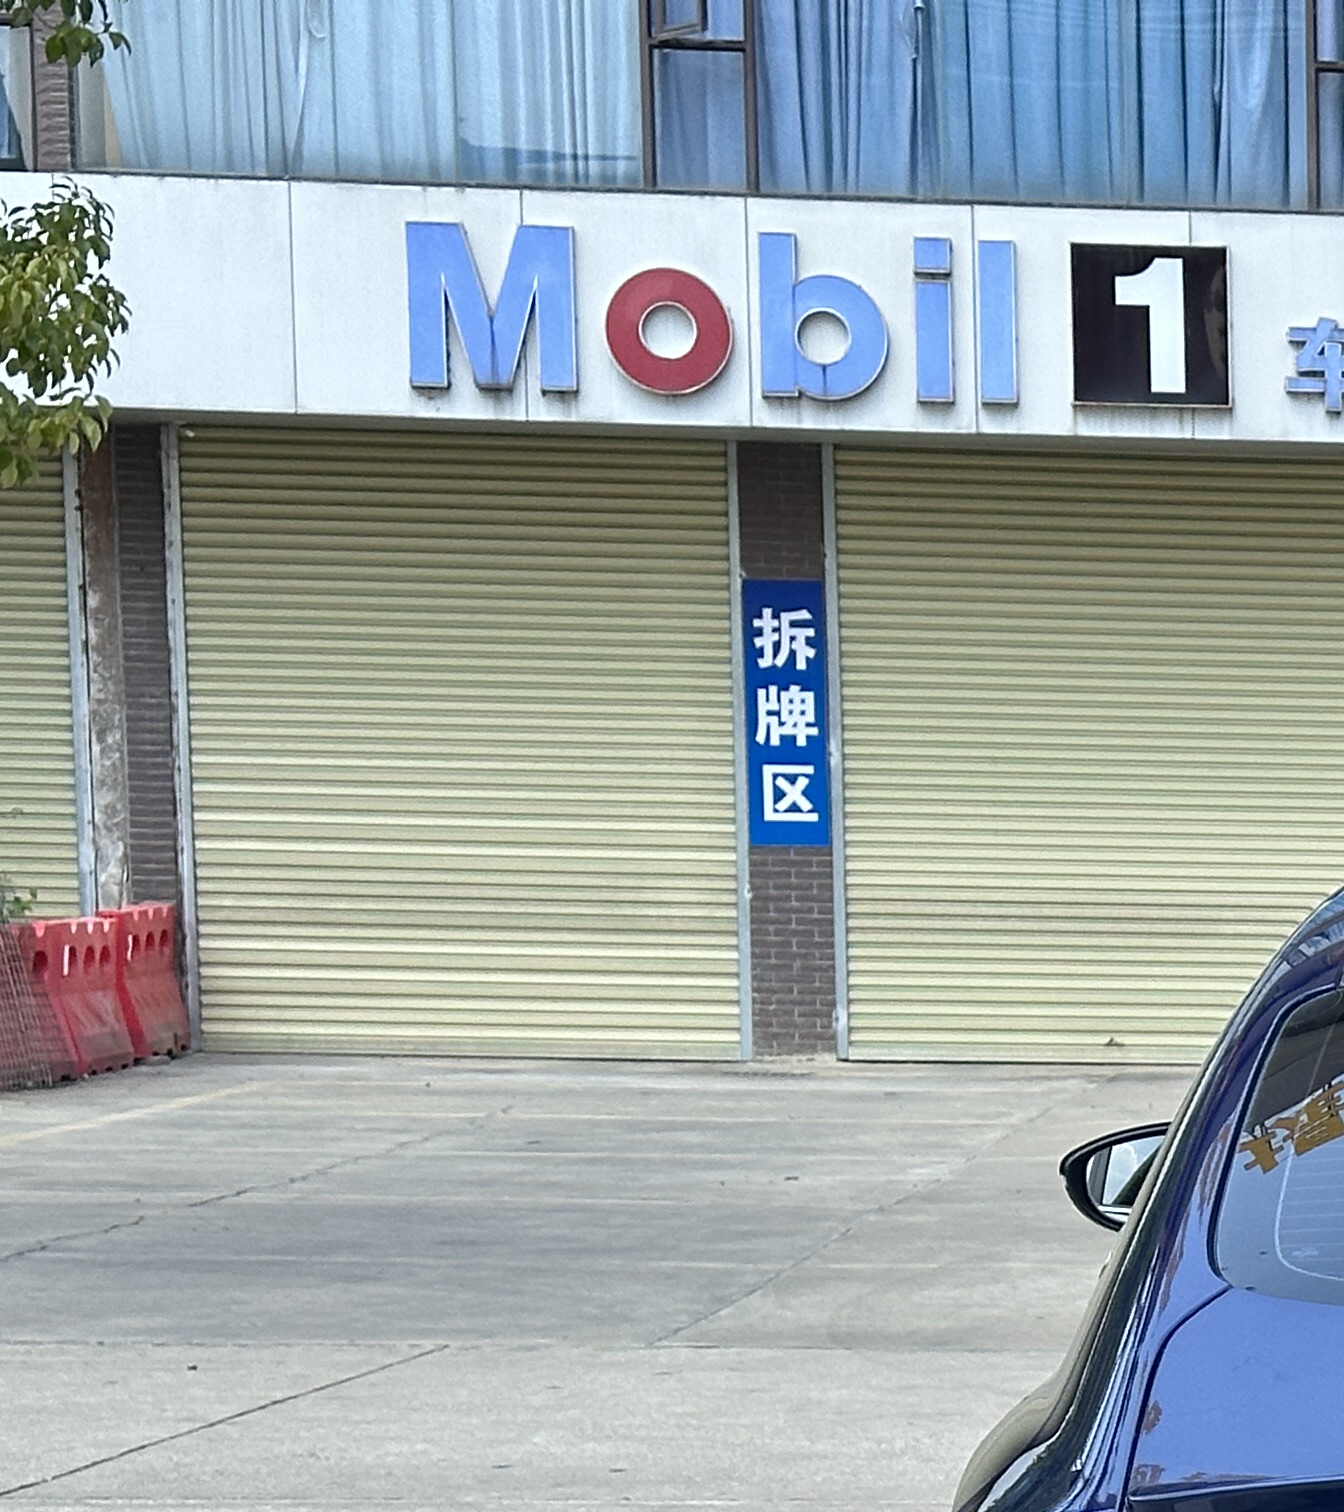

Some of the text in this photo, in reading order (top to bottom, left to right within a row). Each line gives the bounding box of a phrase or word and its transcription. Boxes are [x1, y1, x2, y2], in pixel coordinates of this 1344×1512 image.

[404, 220, 1019, 404] Mobil
[1113, 256, 1187, 394] 1
[751, 607, 820, 824] 拆牌区
